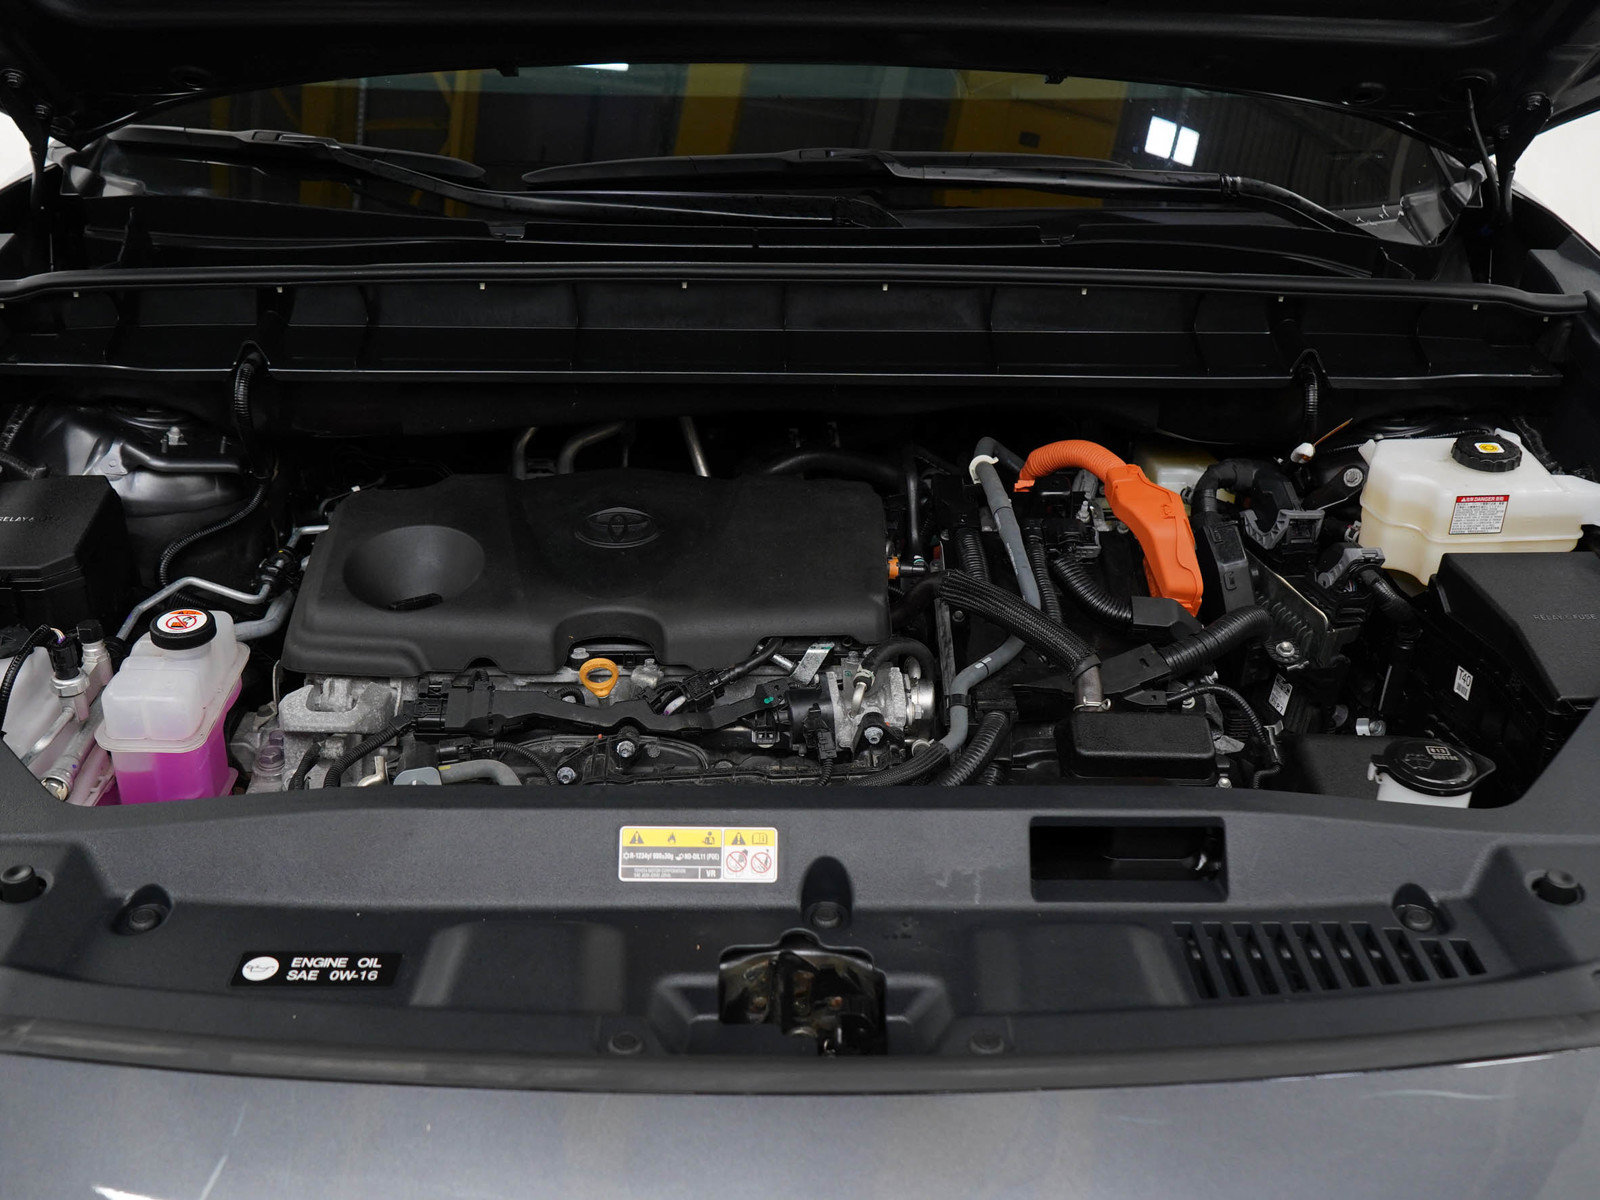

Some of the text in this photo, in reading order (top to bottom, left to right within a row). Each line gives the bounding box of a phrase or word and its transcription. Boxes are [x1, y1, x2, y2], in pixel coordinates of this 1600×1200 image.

[1532, 613, 1563, 621] RELAY
[705, 869, 717, 878] VR
[290, 956, 382, 968] ENGINE OIL
[285, 969, 379, 982] SAE 0W-16
